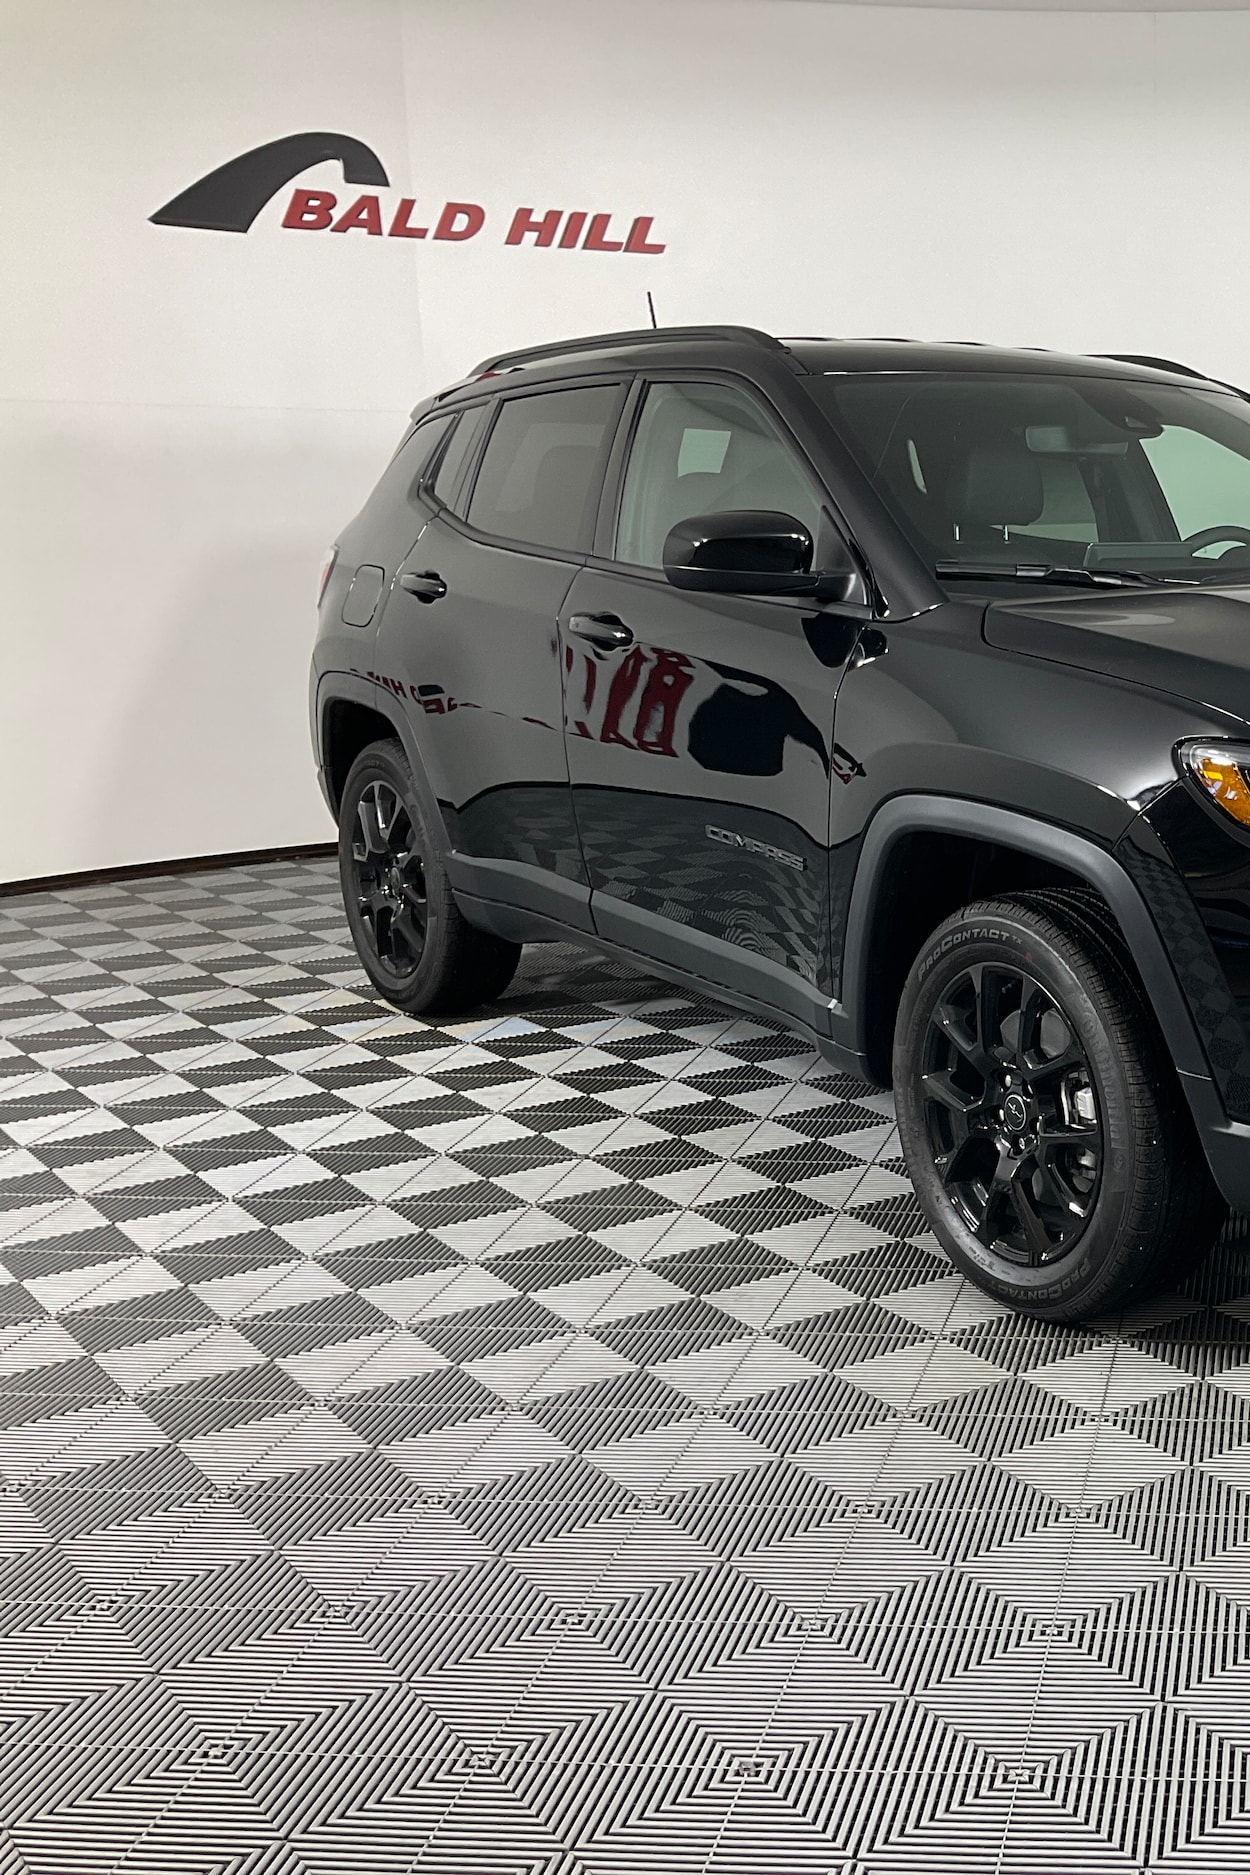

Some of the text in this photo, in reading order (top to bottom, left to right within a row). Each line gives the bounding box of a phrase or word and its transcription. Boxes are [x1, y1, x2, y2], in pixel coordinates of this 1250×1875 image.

[281, 188, 667, 254] BALD HILL
[705, 824, 808, 872] COMPASS
